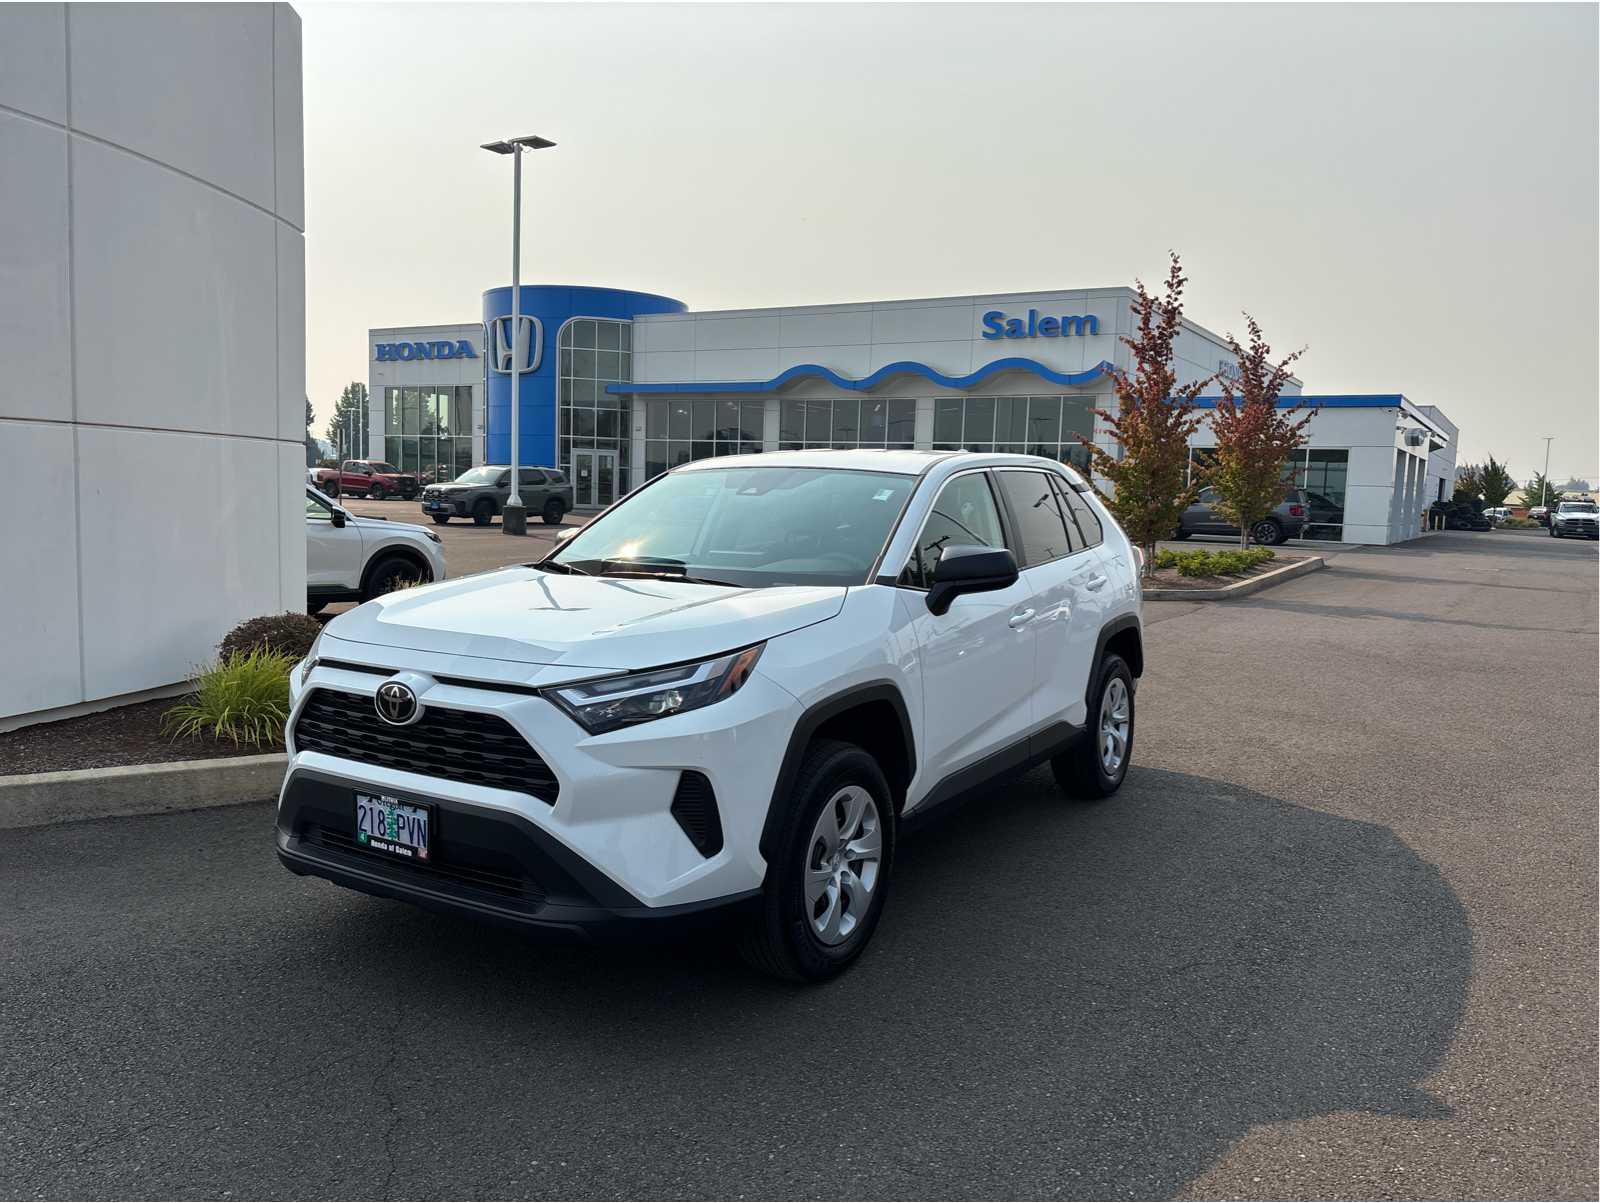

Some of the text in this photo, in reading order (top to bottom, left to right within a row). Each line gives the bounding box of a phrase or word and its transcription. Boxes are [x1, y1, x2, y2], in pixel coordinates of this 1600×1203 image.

[982, 308, 1099, 340] Salem
[375, 339, 479, 362] HONDA
[358, 804, 426, 848] 218 PVN
[371, 839, 387, 850] Honda
[388, 844, 395, 852] of
[395, 845, 412, 857] Salem
